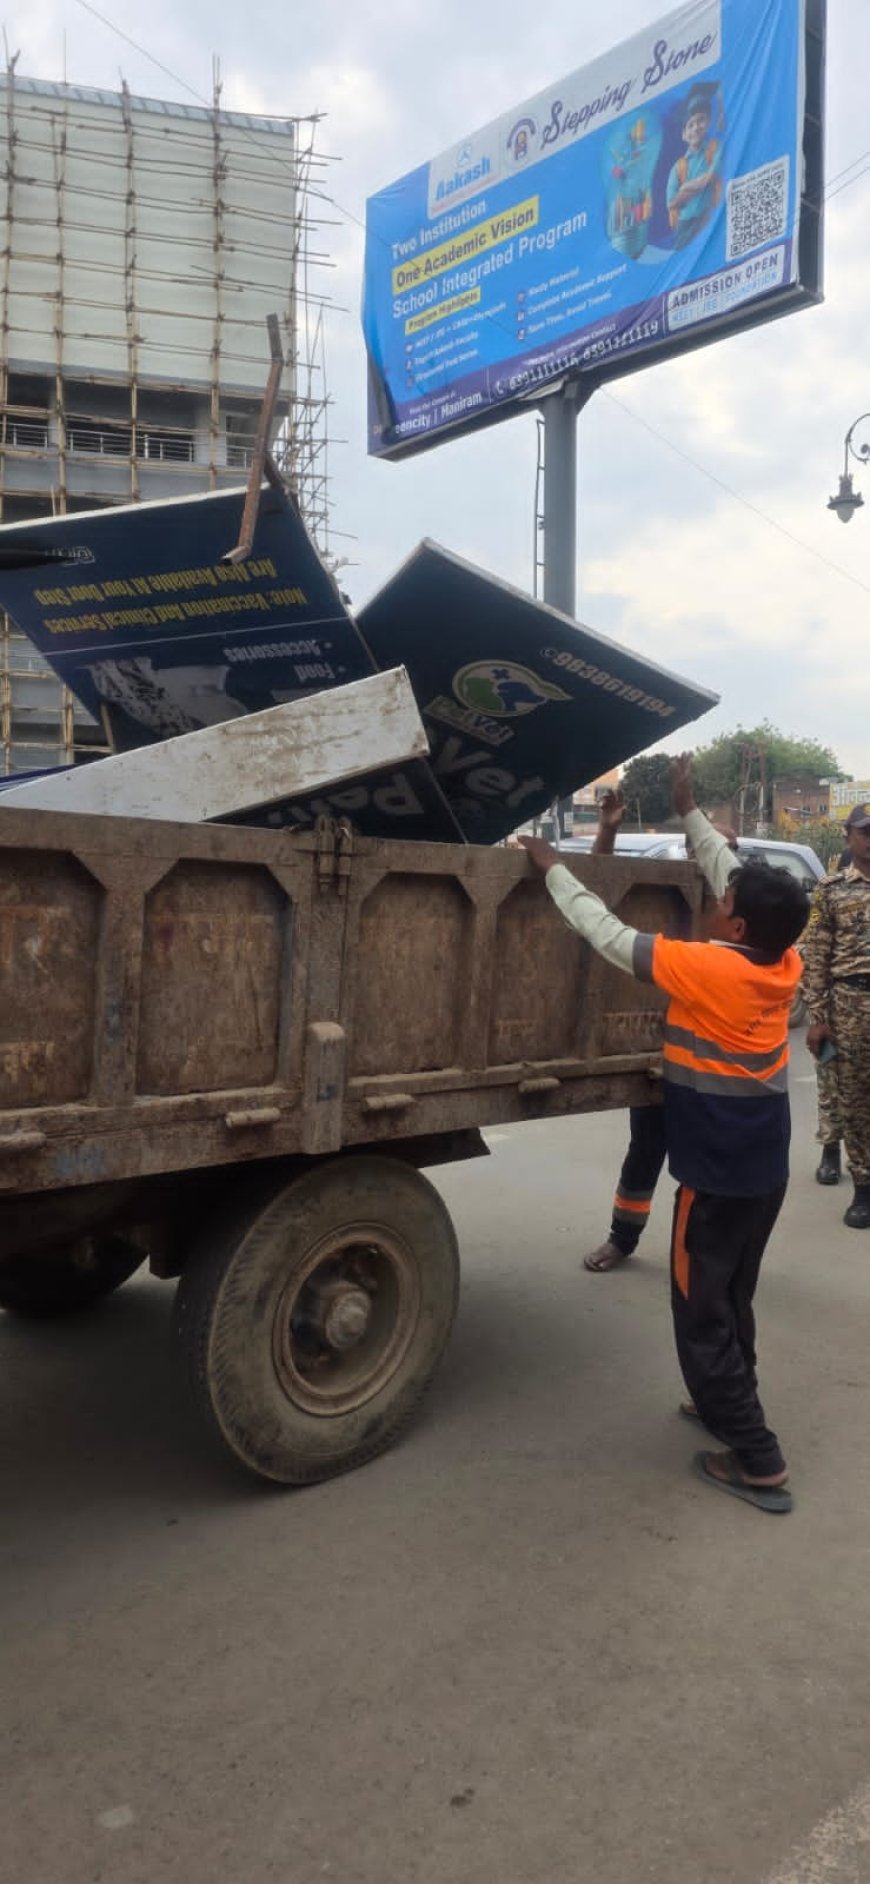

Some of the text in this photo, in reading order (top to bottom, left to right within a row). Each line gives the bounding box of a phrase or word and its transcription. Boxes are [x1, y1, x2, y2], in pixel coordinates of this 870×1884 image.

[541, 31, 717, 150] Stepping Stone
[436, 156, 490, 200] Aakash
[392, 200, 486, 260] Two Institution
[396, 206, 534, 287] One Academic Vision
[393, 285, 437, 319] School
[442, 243, 513, 296] Integrated
[519, 211, 587, 257] Program
[673, 253, 778, 307] ADMISSION OPEN
[441, 392, 482, 418] Maniram
[33, 558, 277, 606] Are Also Available At Your Door Step
[181, 592, 270, 616] Vaccination
[44, 613, 107, 633] Services
[153, 603, 185, 622] And
[223, 640, 321, 662] Accessories
